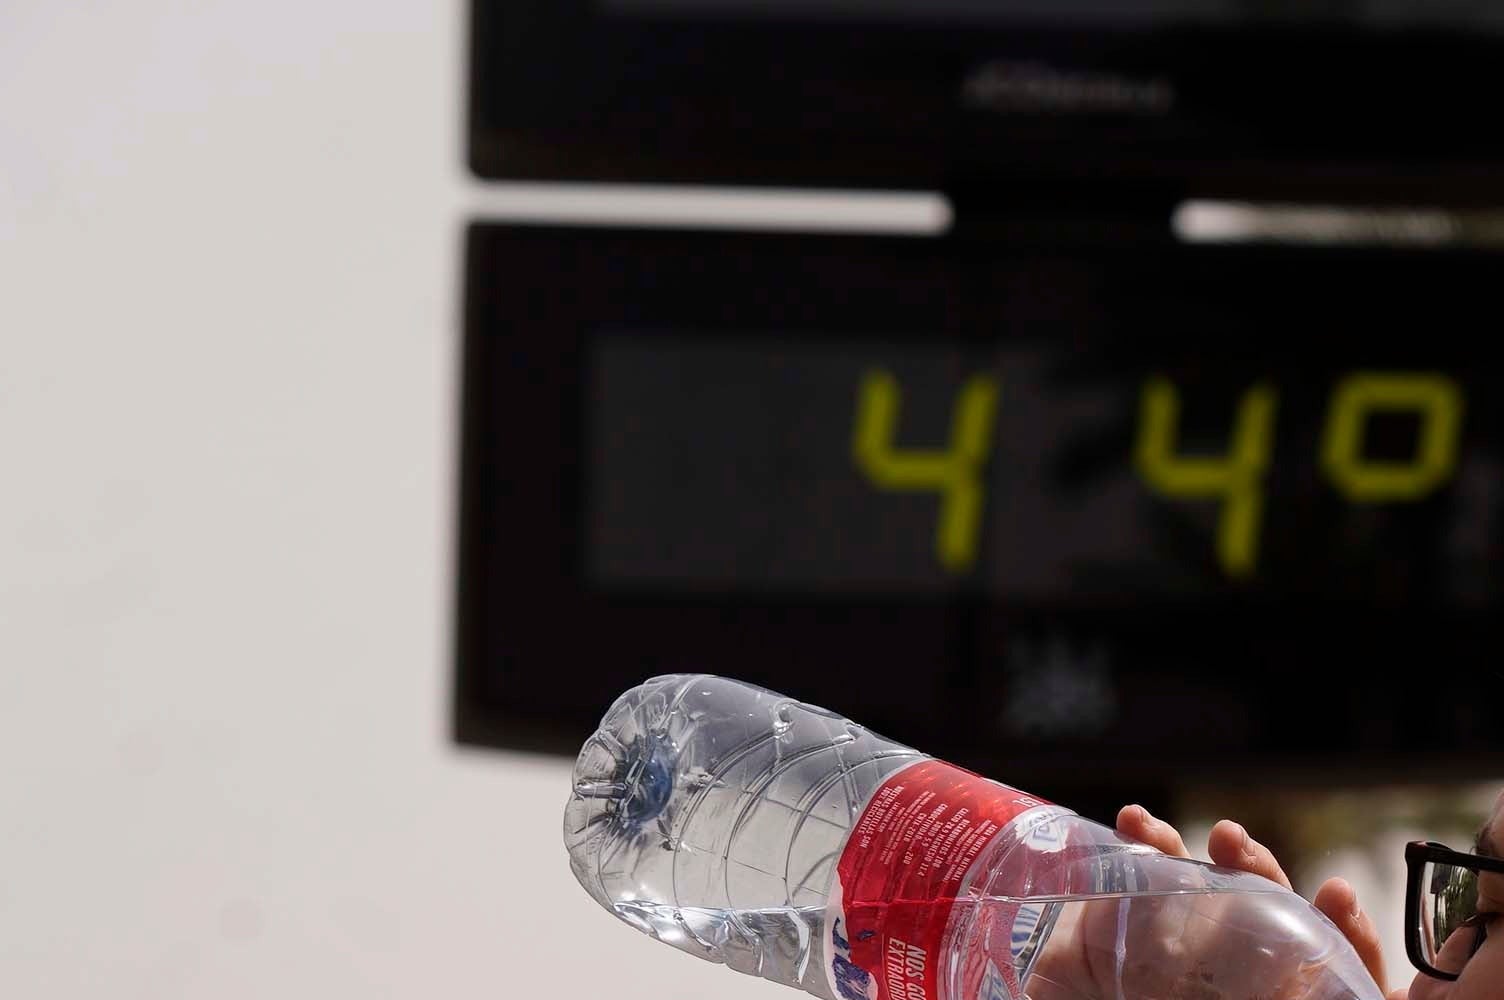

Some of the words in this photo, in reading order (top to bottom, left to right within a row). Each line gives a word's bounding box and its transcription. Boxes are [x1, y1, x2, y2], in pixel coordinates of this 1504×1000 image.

[880, 783, 904, 809] NUESTRAS
[857, 798, 882, 835] RECICLABLES
[865, 806, 886, 836] BOTELLAS
[859, 834, 871, 849] SON
[923, 832, 946, 863] MAGNESIO
[966, 834, 987, 857] MINERAL
[951, 856, 972, 882] NATURAL
[905, 944, 926, 979] NOS
